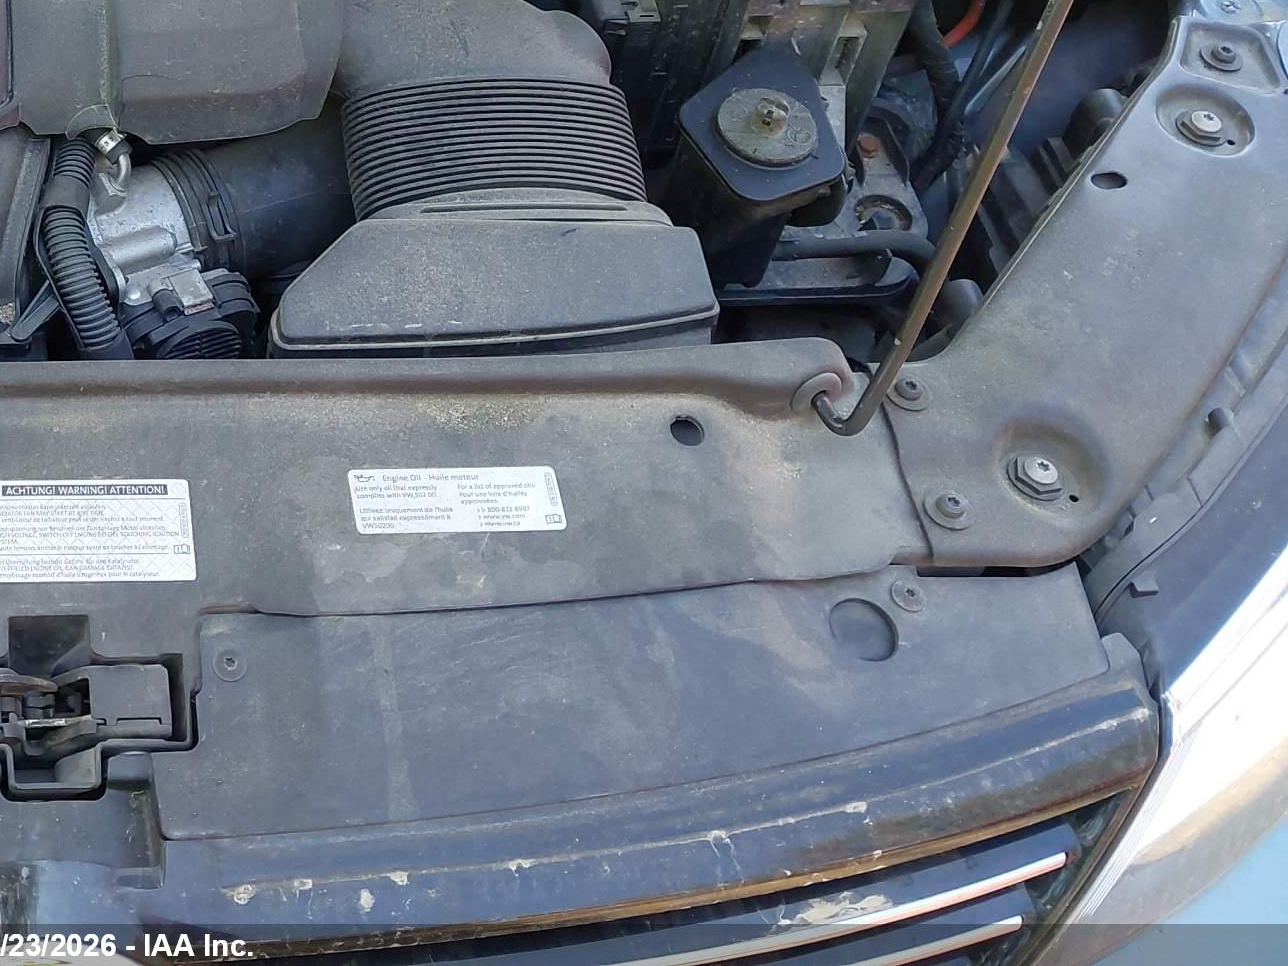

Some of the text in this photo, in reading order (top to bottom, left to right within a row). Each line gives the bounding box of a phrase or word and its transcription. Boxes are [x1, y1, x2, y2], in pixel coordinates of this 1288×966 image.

[382, 475, 409, 483] Engine
[6, 485, 166, 495] ACHTUNG! WARNING! ATTENTION!
[408, 484, 437, 492] expressly
